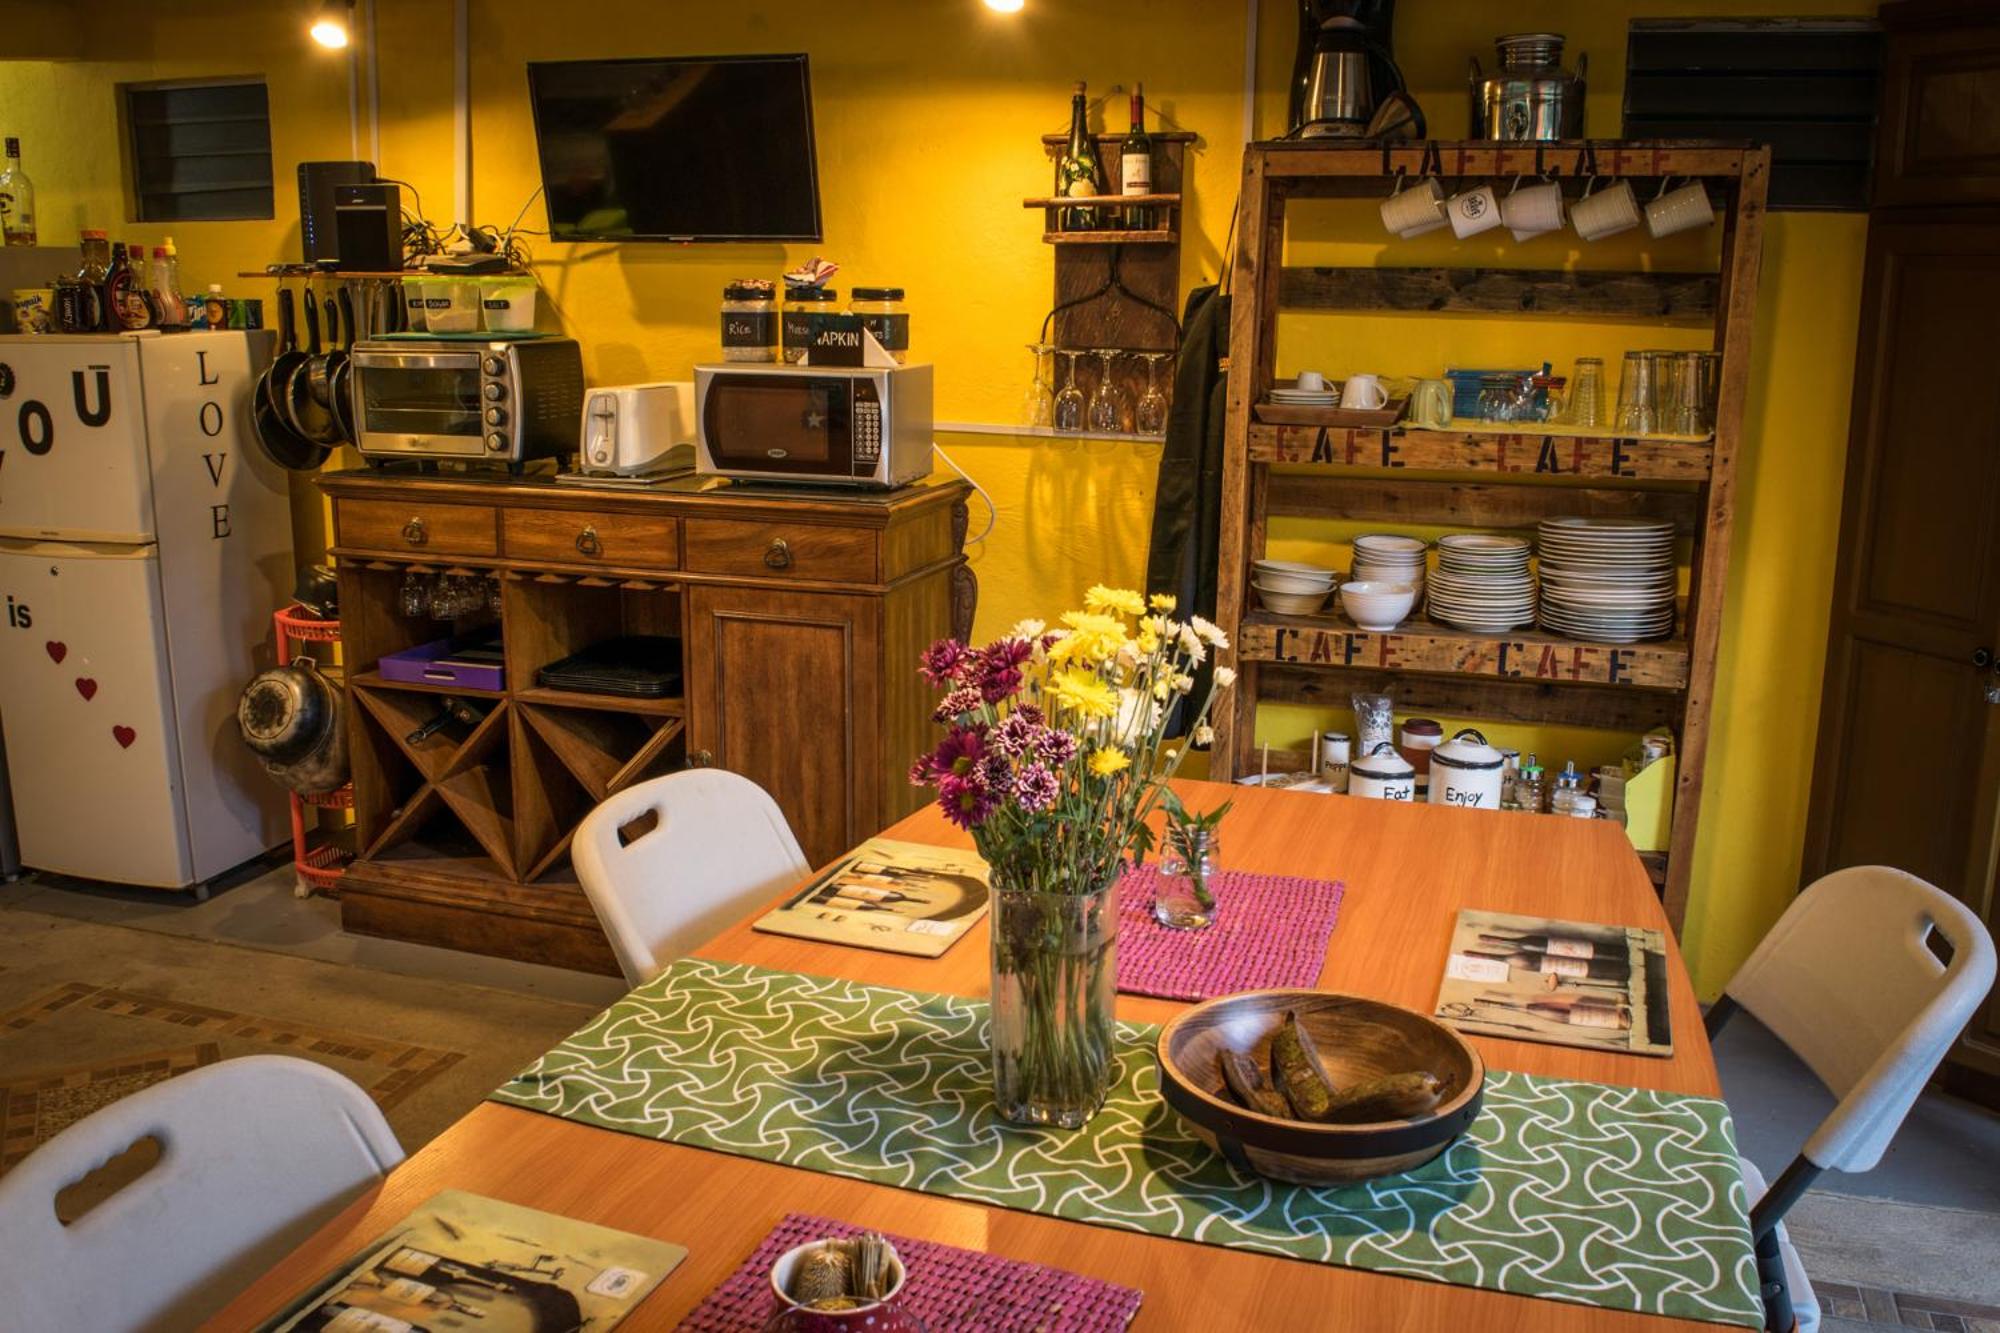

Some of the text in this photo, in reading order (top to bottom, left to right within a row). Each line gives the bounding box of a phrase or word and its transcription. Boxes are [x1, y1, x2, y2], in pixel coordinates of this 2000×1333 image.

[1383, 141, 1679, 176] CAFE CAFE
[0, 365, 111, 466] OU
[196, 351, 232, 539] LOVE
[1277, 425, 1638, 477] CAFE CAFE
[7, 595, 33, 629] is
[1276, 628, 1636, 685] CAFE CAFE
[1384, 785, 1411, 801] Eat
[1446, 786, 1483, 807] Enjoy
